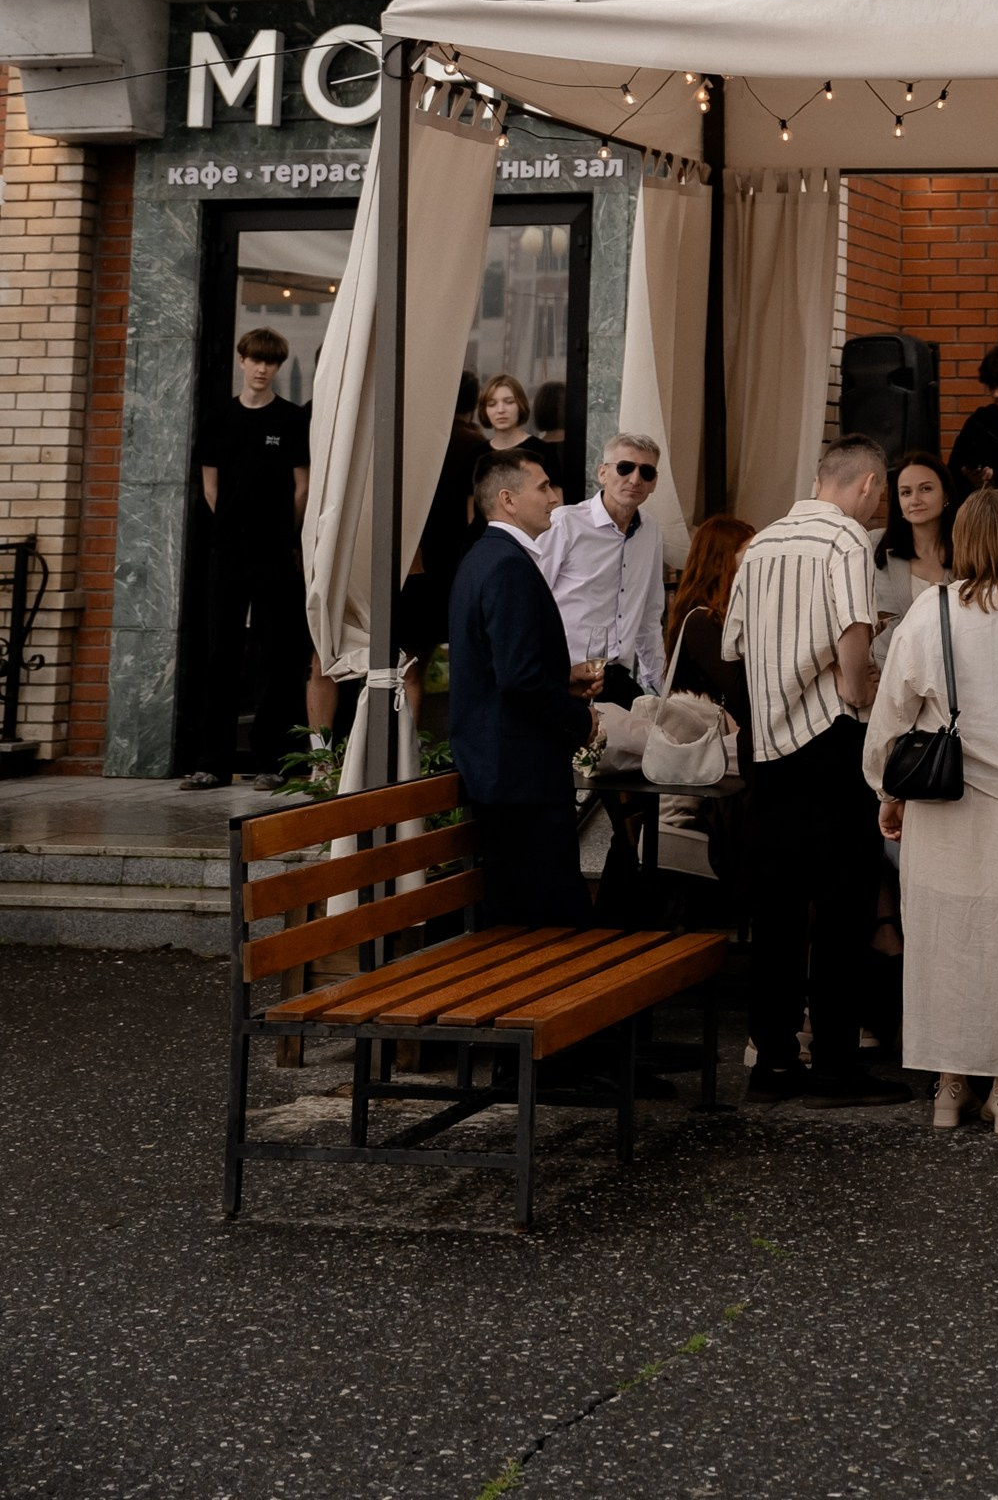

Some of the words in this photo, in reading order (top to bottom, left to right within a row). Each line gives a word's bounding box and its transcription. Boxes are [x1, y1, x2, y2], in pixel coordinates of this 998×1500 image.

[187, 23, 500, 129] МО
[168, 161, 239, 190] кафе
[497, 153, 560, 179] ный
[573, 158, 623, 178] зал
